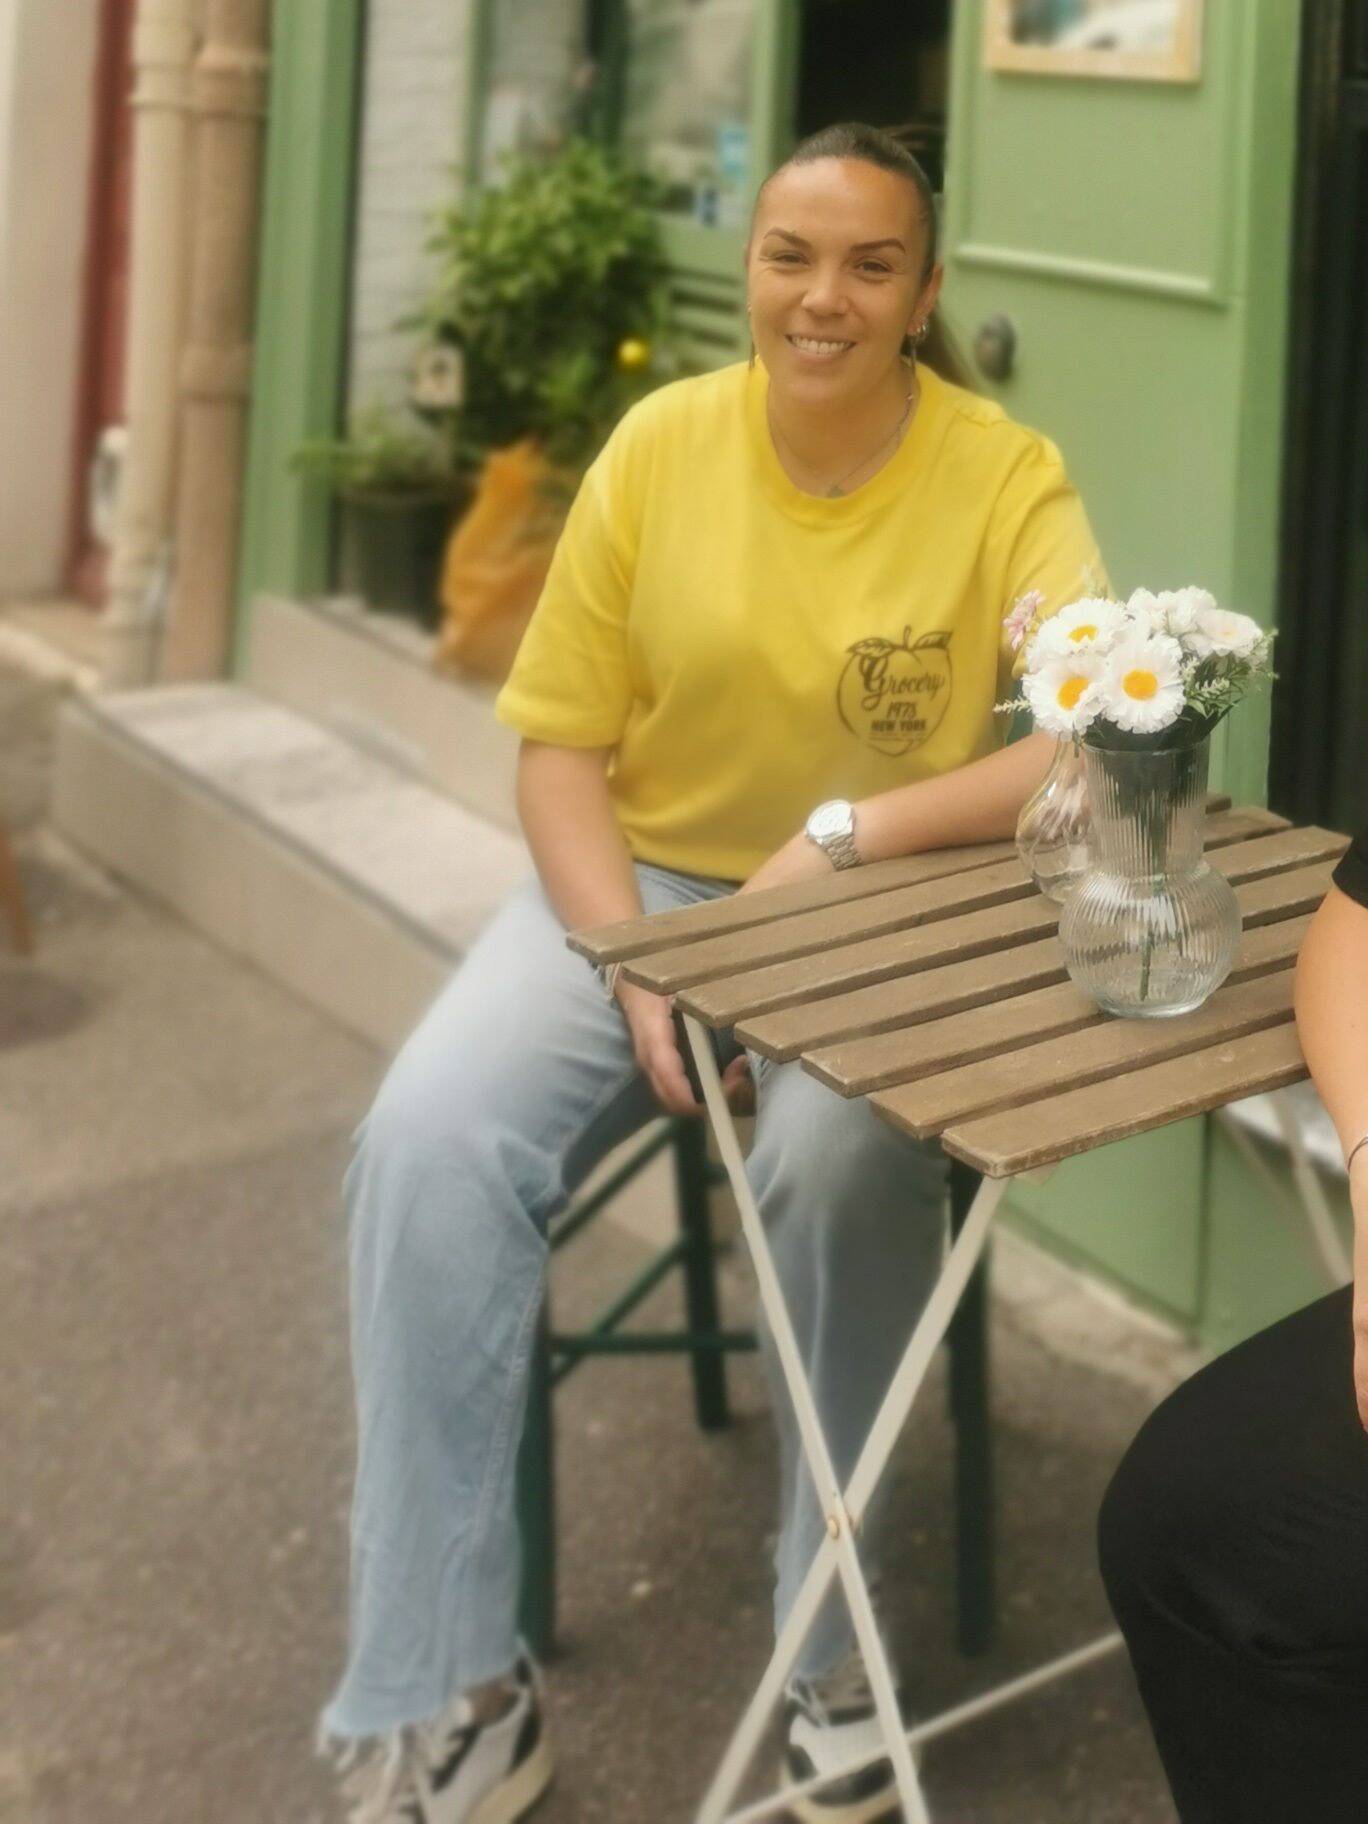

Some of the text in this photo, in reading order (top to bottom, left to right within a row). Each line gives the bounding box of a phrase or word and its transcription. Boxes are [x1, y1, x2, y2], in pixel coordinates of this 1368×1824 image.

[859, 654, 945, 712] Grocery
[871, 719, 927, 732] NEW YORK
